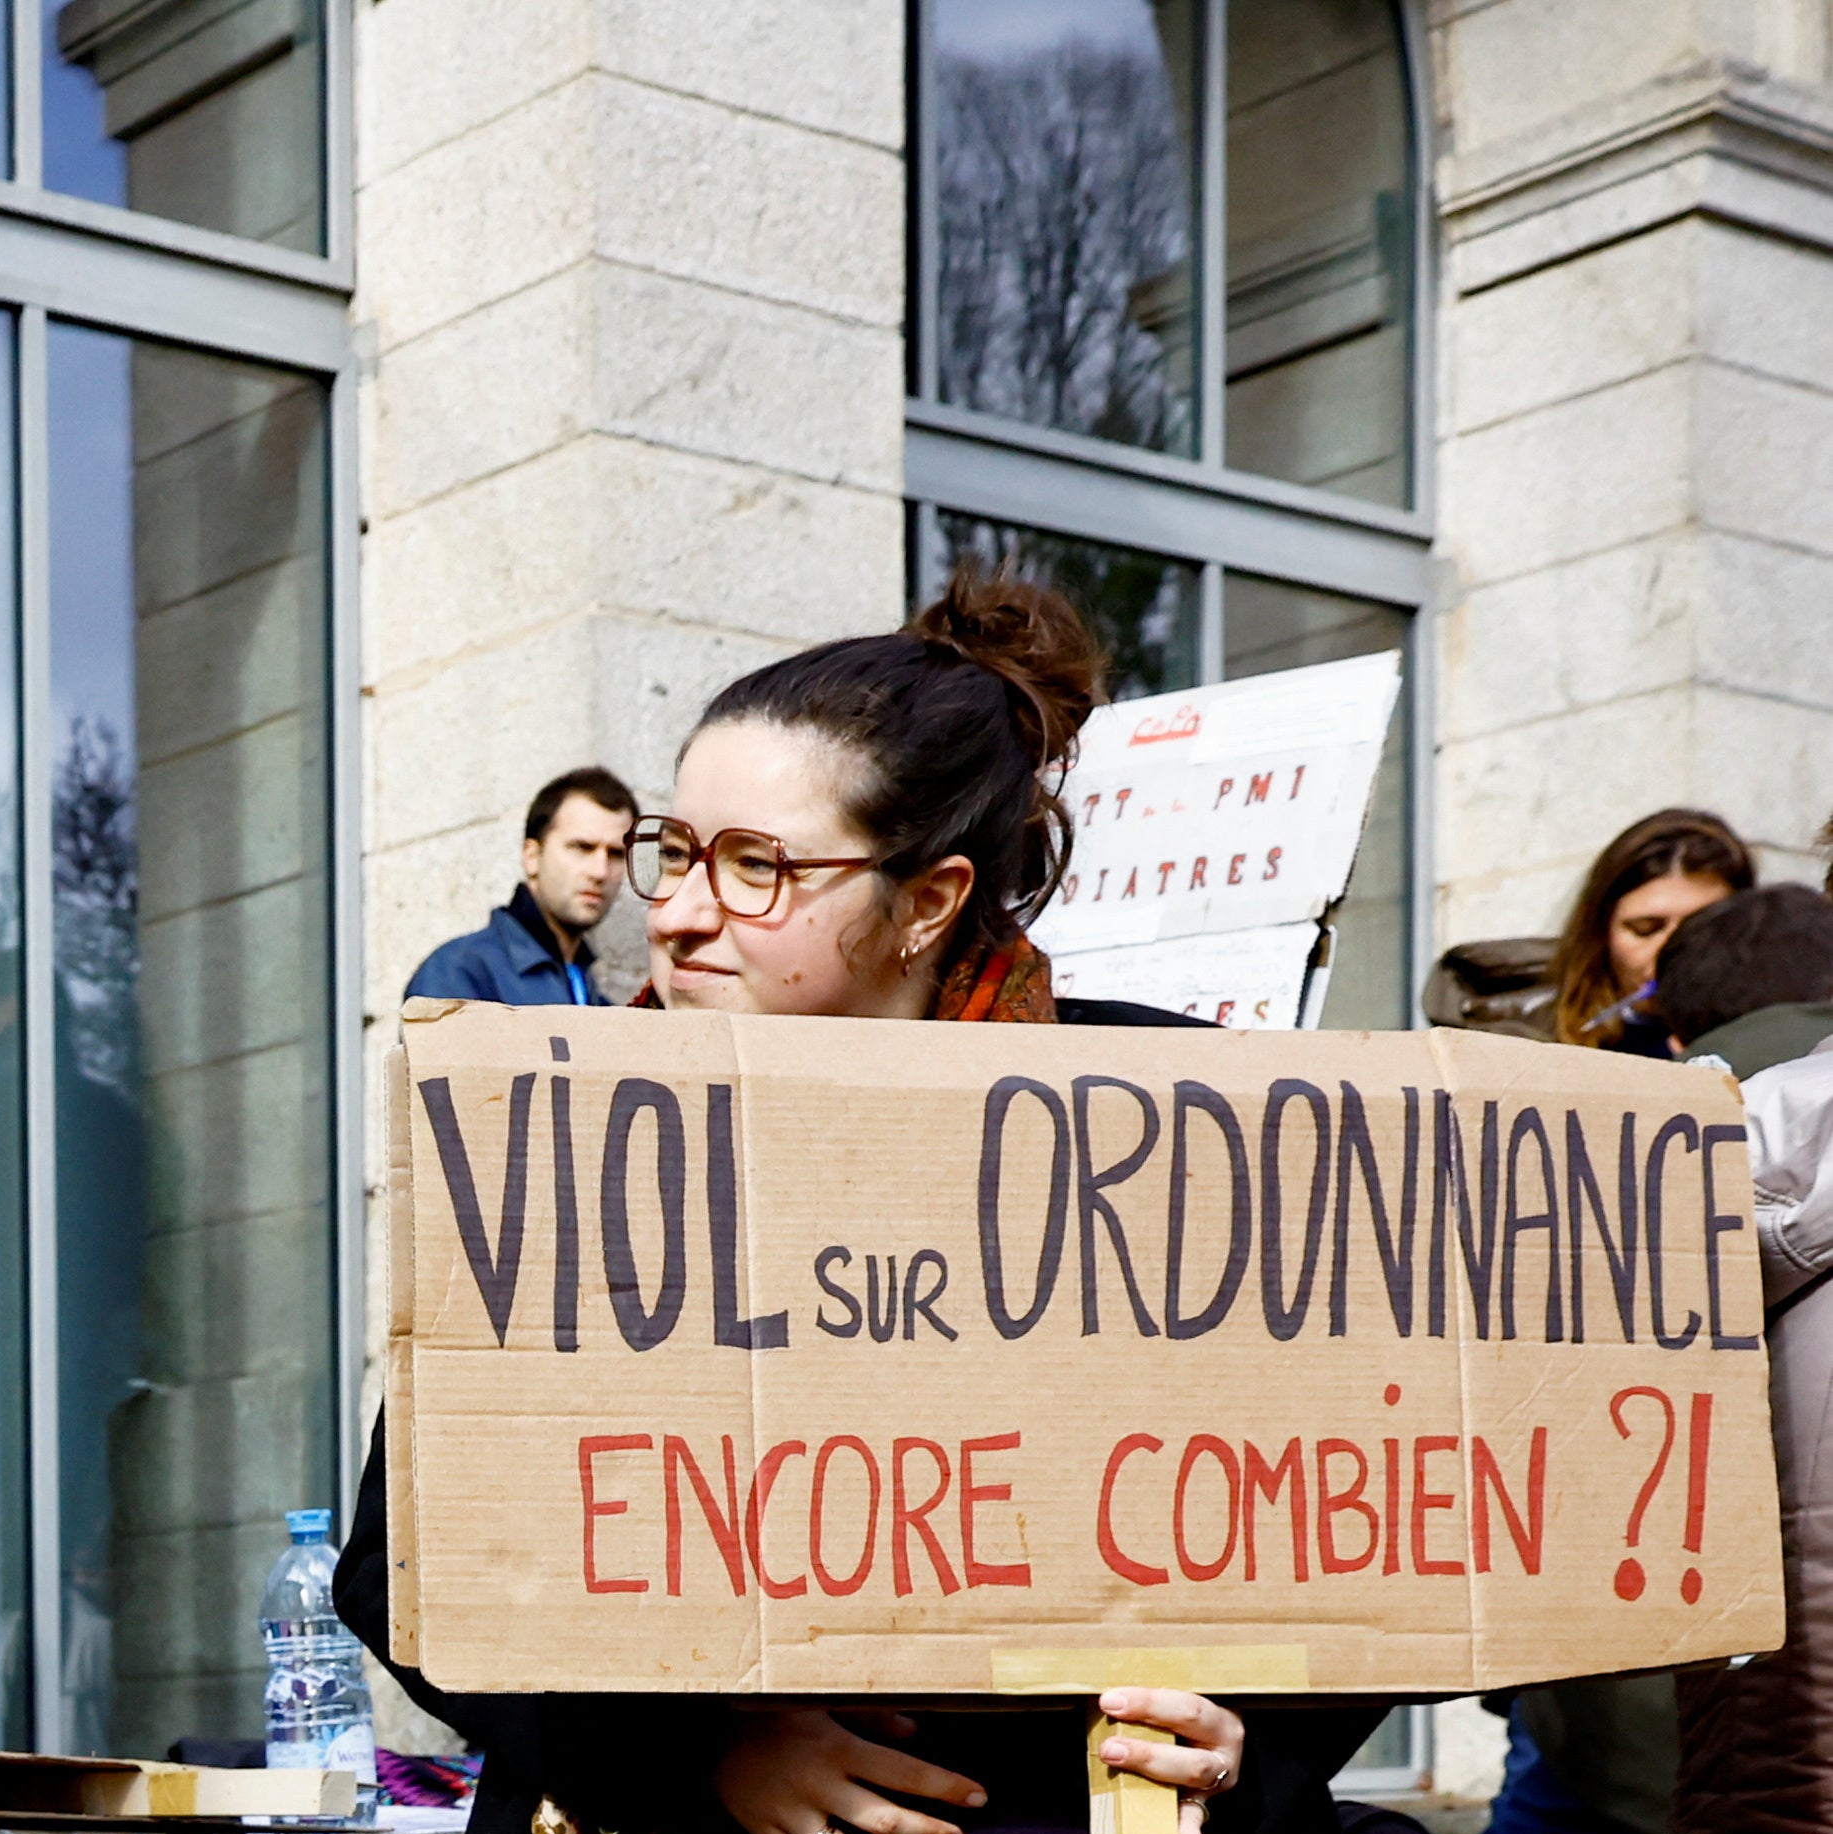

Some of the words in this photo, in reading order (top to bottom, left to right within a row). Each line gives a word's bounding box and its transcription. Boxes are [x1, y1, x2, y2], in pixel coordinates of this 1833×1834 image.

[1061, 847, 1283, 905] DIATRES
[417, 1036, 789, 1353] VIOL
[815, 1243, 958, 1342] SUR
[979, 1074, 1760, 1351] ORDONNANCE
[578, 1431, 1031, 1600] ENCORE
[1096, 1384, 1547, 1586] COMBIEN
[1608, 1386, 1711, 1604] ?!
